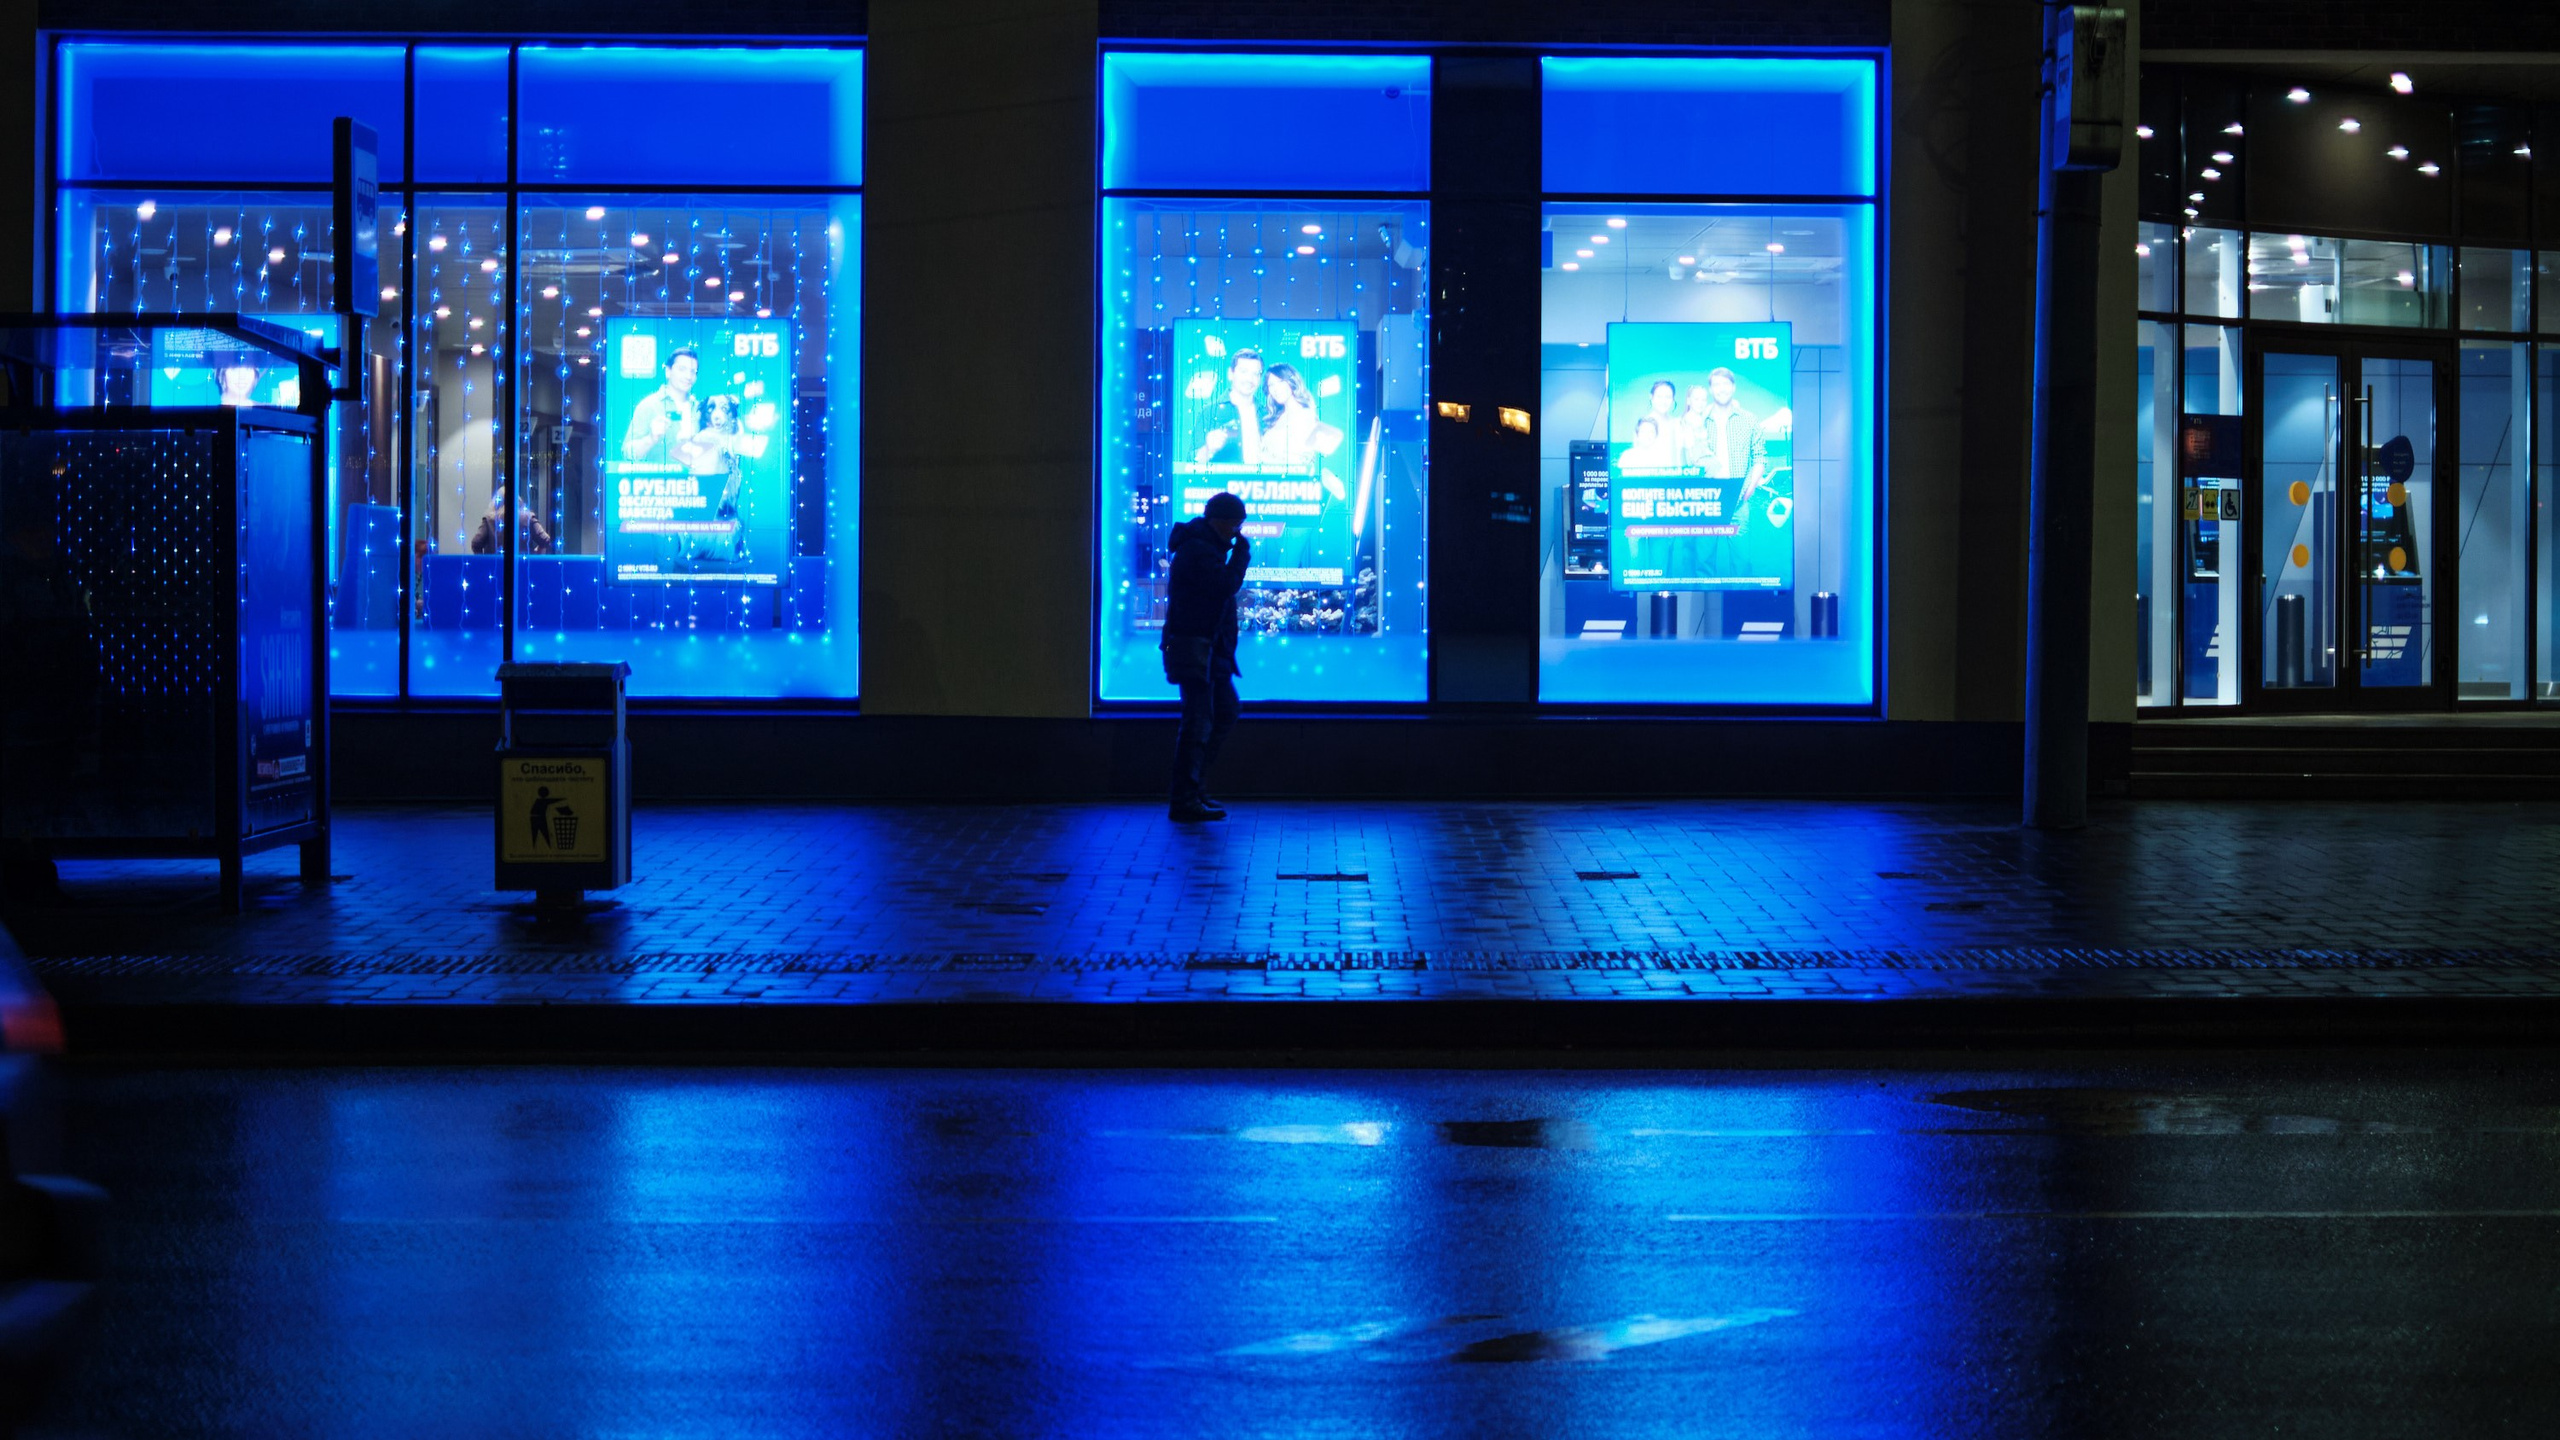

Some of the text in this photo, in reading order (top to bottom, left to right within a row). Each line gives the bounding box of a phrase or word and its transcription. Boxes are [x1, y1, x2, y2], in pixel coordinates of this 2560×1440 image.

[734, 333, 779, 357] ВТБ
[1300, 335, 1345, 358] ВТБ
[1734, 337, 1779, 359] ВТБ
[632, 476, 699, 496] РУБЛЕЙ
[1227, 480, 1322, 501] РУБЛЯМИ
[1666, 488, 1683, 500] НА
[1684, 488, 1722, 500] МЕЧТУ
[618, 496, 707, 508] ОБСЛУЖИВАНИЕ
[1621, 500, 1722, 520] ЕЩЁ БЫСТРЕЕ
[618, 507, 674, 520] НАВСЕГДА
[1241, 524, 1262, 535] РТОЙ
[520, 762, 587, 776] Спасибо,
